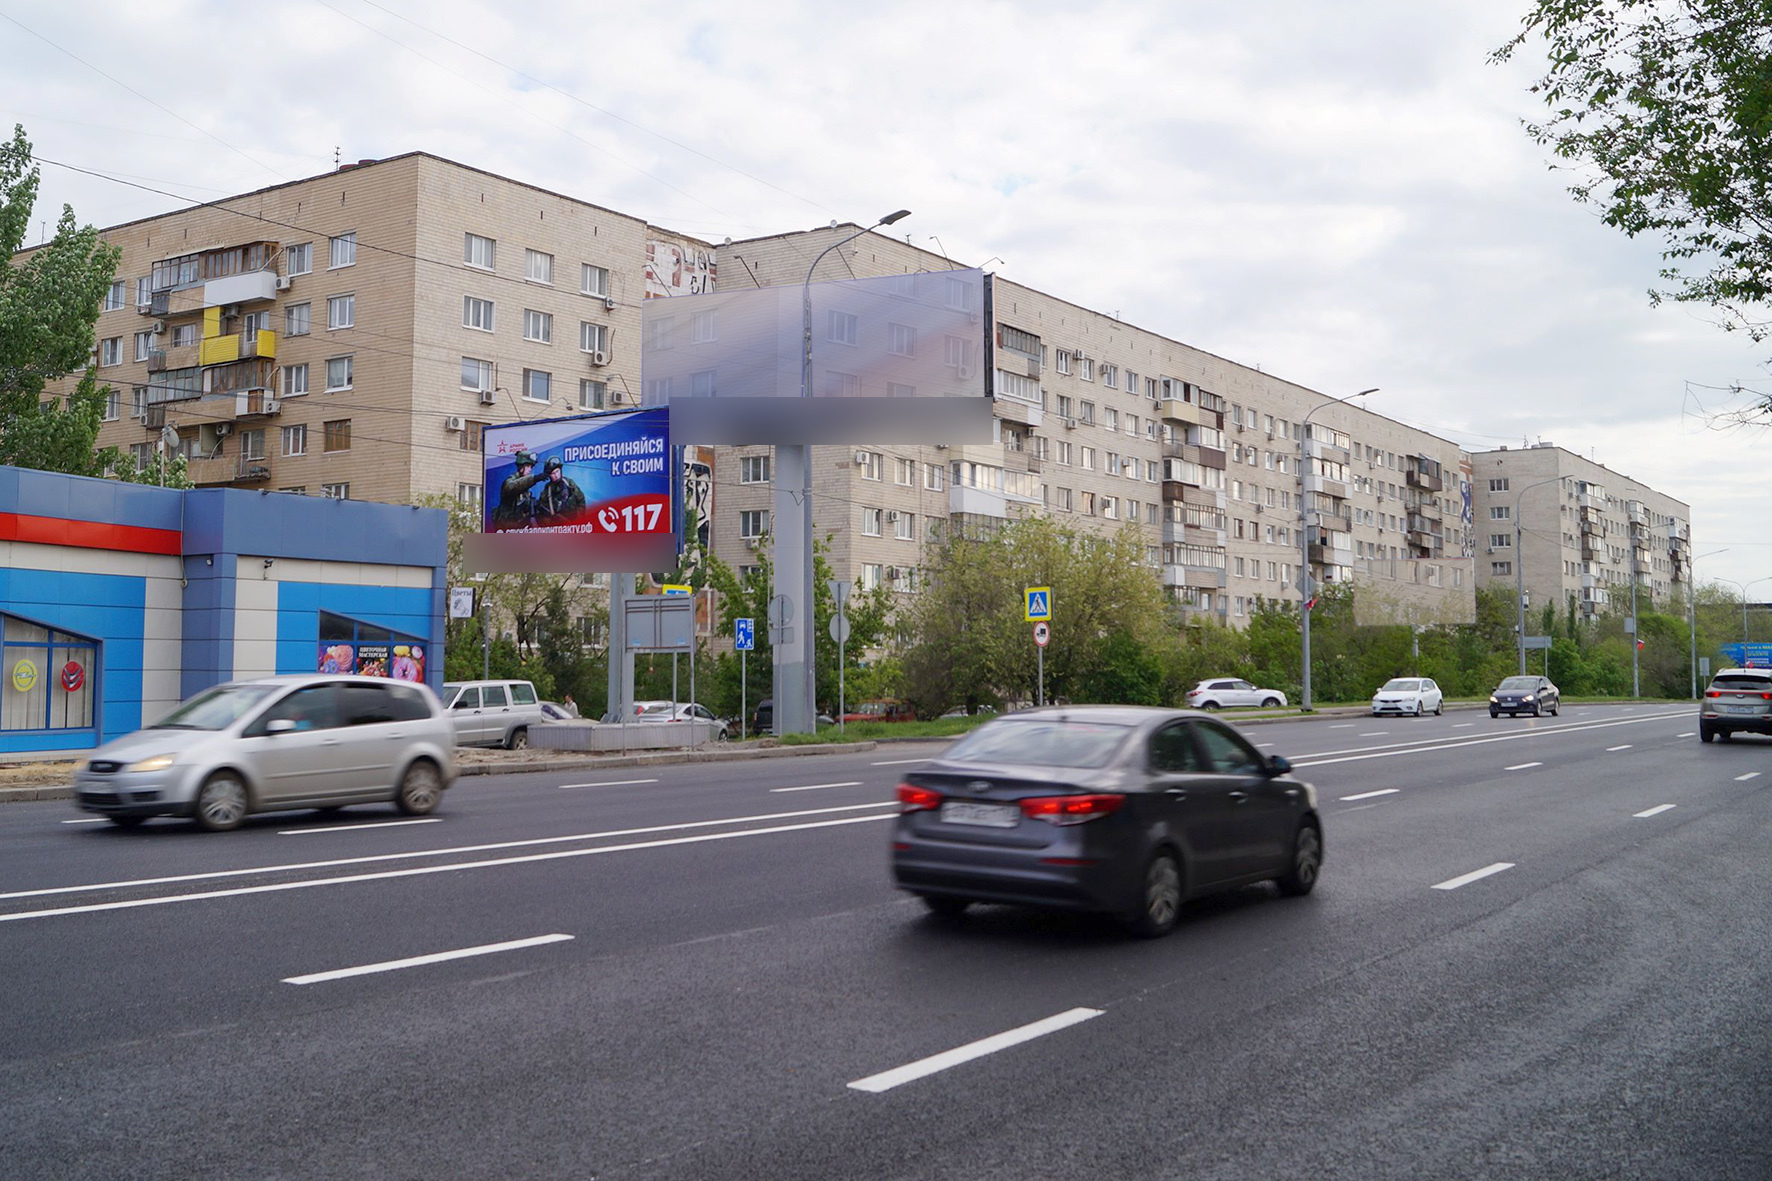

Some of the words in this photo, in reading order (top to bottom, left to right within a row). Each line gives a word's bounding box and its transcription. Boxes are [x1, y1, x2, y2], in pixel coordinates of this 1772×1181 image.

[564, 437, 663, 462] ПРИСОЕДИНЯЙСЯ
[612, 461, 620, 476] К
[623, 457, 663, 475] СВОИМ
[621, 503, 663, 532] 117
